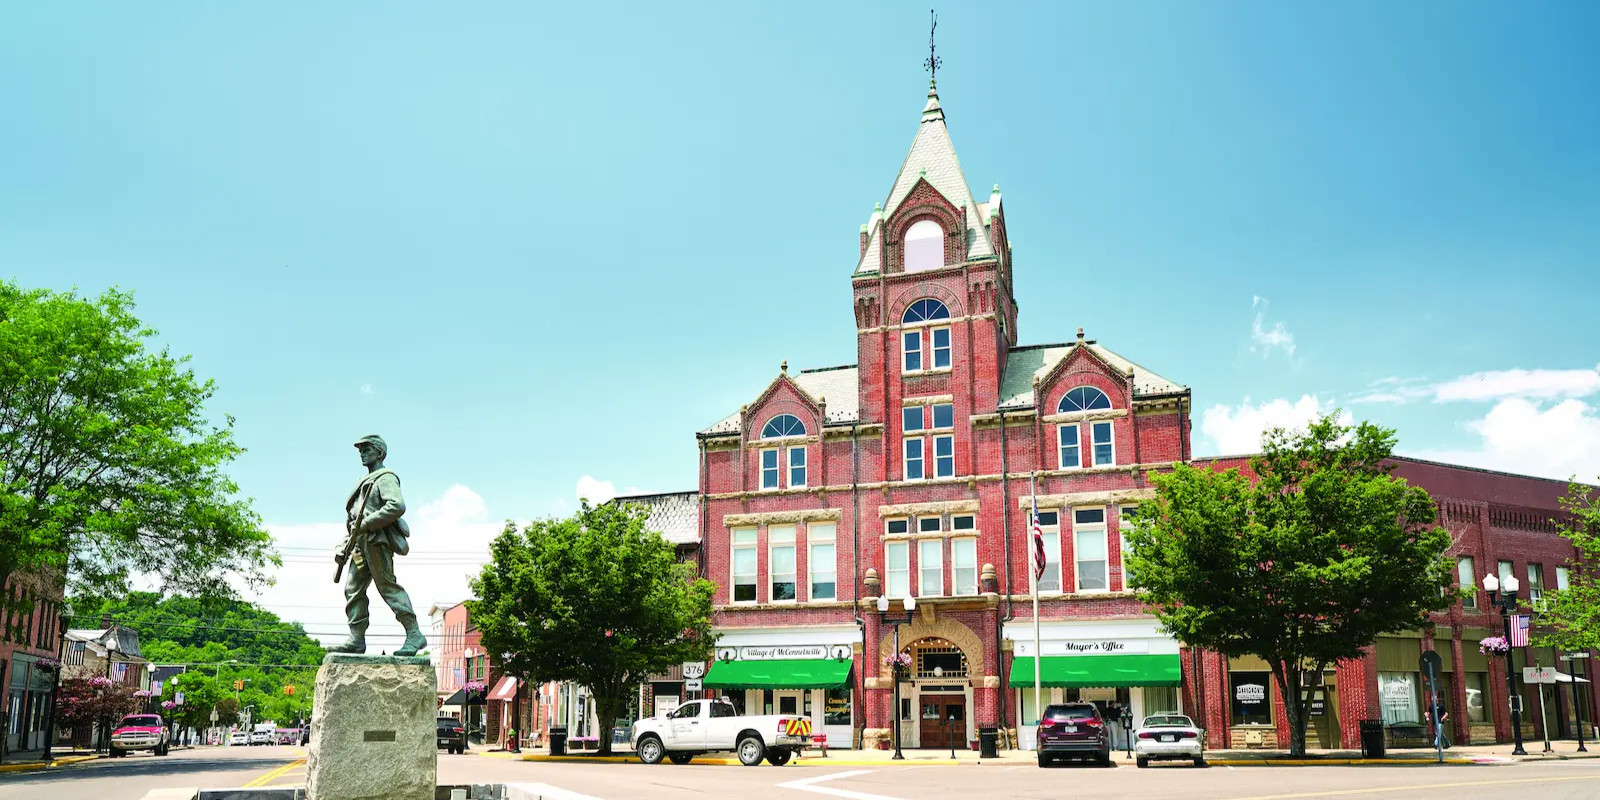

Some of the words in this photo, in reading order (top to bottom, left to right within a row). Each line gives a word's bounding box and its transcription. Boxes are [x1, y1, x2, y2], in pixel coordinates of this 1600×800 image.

[937, 620, 983, 655] HOUSE
[1065, 642, 1099, 652] Mayor's
[1101, 641, 1125, 651] Office
[747, 649, 768, 657] Village
[769, 648, 775, 657] of
[777, 648, 821, 656] McConnelsville
[685, 665, 703, 675] 376
[828, 697, 848, 705] Council
